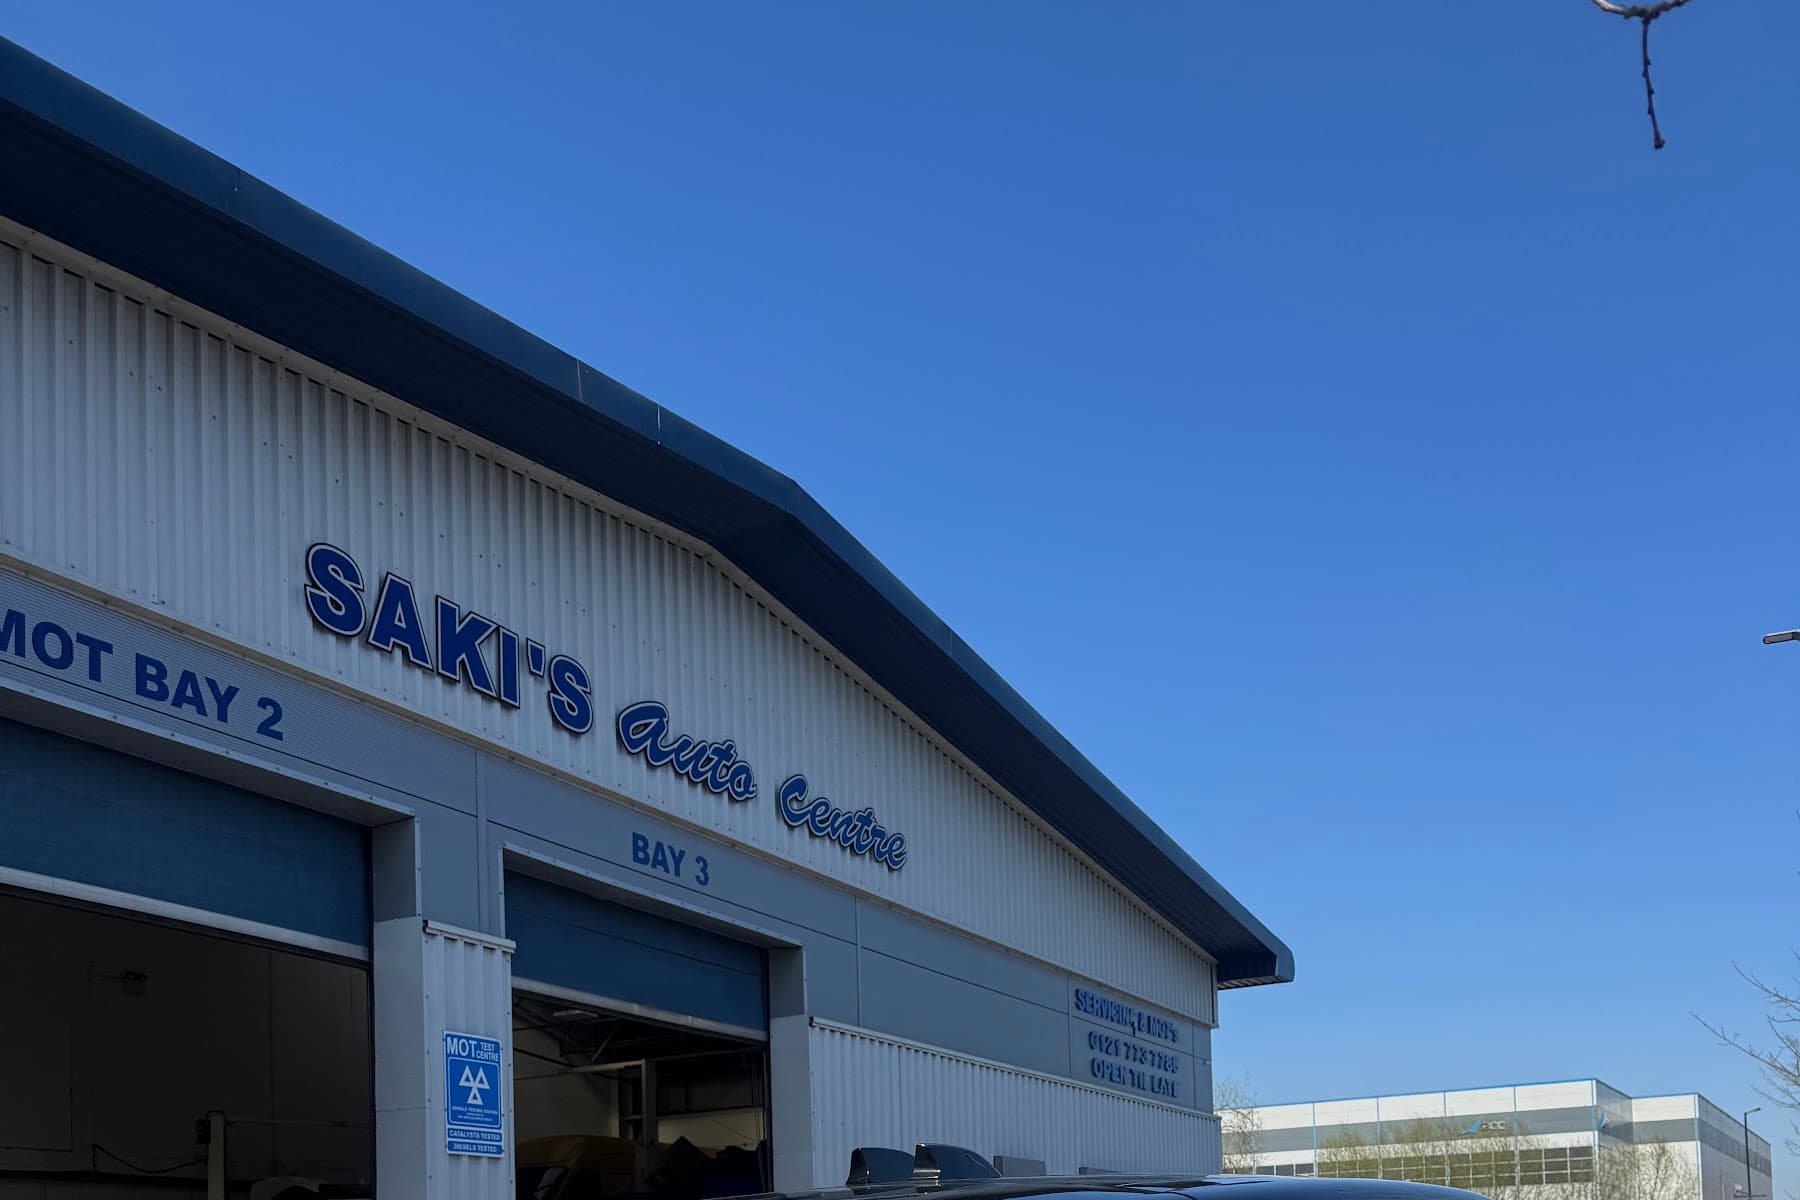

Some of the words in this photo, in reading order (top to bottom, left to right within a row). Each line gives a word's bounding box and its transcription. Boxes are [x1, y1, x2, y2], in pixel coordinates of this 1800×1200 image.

[304, 542, 594, 734] SAKI'S
[0, 608, 113, 683] MOT
[135, 652, 239, 723] BAY
[256, 696, 284, 741] 2
[632, 832, 686, 878] BAY
[695, 856, 710, 886] 3
[447, 1036, 478, 1058] MOT
[480, 1041, 495, 1051] TEST
[1088, 1030, 1120, 1057] 0121
[477, 1050, 499, 1062] CENTRE
[1091, 1057, 1126, 1086] OPEN
[477, 1145, 498, 1153] TESTED
[481, 1133, 501, 1141] TESTED
